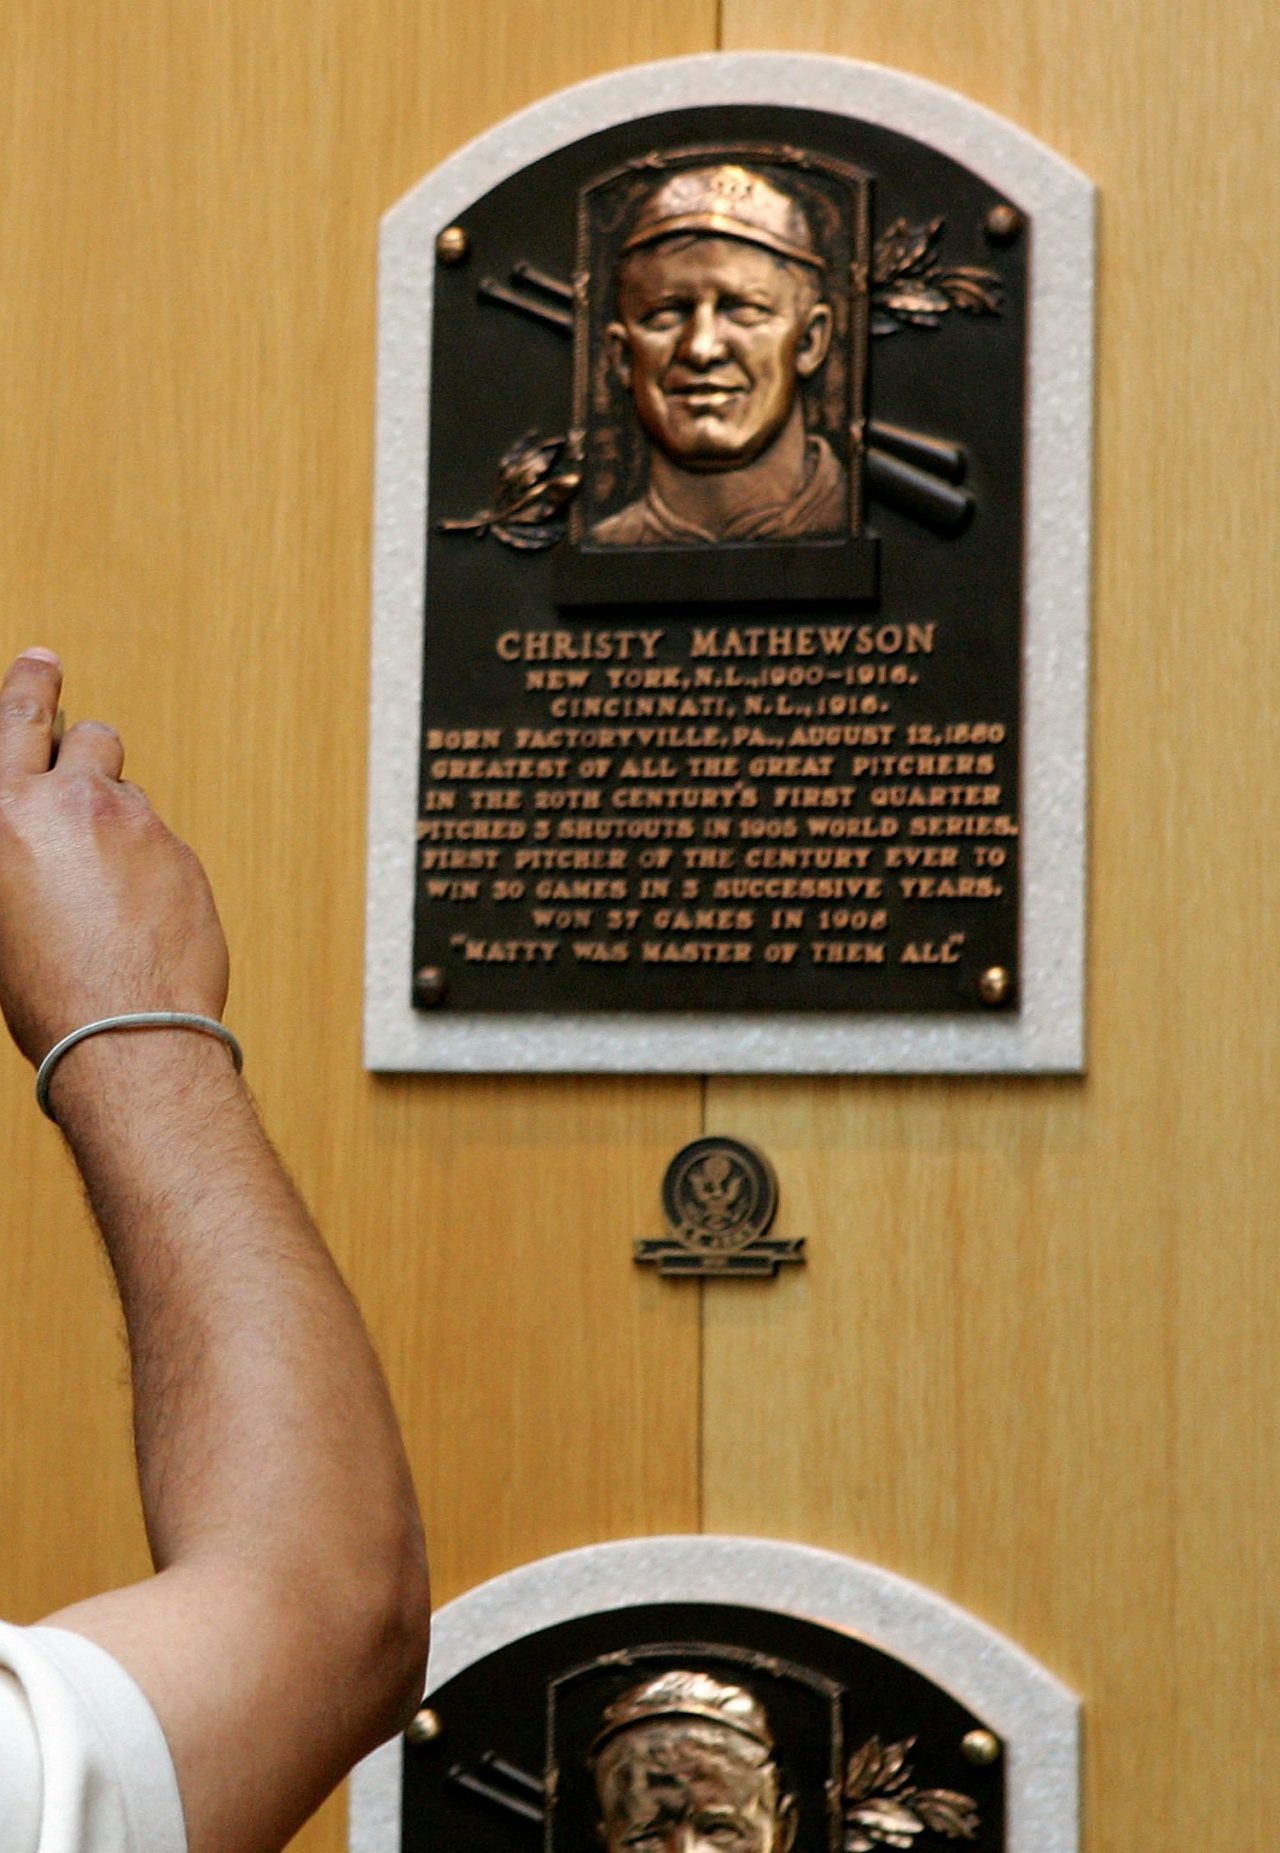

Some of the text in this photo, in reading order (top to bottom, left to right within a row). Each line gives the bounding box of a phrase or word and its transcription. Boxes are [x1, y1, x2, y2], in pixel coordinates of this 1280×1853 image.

[495, 622, 936, 661] CHRISTY MATHEWSON
[526, 668, 590, 690] NEW
[426, 728, 502, 750] BORN
[788, 723, 896, 747] AUGUST
[430, 753, 995, 780] GREATEST OF ALL THE GREAT PITCHERS
[424, 788, 456, 811] IN
[469, 788, 522, 810] THE
[534, 788, 601, 809] 20TH
[773, 785, 856, 808] FIRST
[870, 784, 1002, 807] QUARTER
[416, 818, 527, 841] PITCHED
[533, 819, 550, 840] 3
[557, 817, 695, 839] SHUTOUTS
[703, 817, 731, 838] IN
[806, 816, 899, 838] WORLD
[909, 814, 1020, 836] SERIES.
[422, 845, 1007, 870] FIRST PITCHER OF THE CENTURY EVER TO
[426, 878, 480, 899] WIN
[492, 879, 525, 900] 30
[535, 879, 627, 899] GAMES
[639, 878, 670, 899] IN
[713, 877, 883, 899] SUCCESSIVE
[900, 876, 1003, 898] YEARS.
[531, 908, 591, 929] WON
[607, 908, 640, 929] 37
[653, 908, 754, 930] GAMES
[771, 909, 804, 929] IN
[572, 941, 629, 961] WAS
[642, 941, 752, 962] MASTER
[764, 942, 798, 963] OF
[812, 941, 884, 963] THEM
